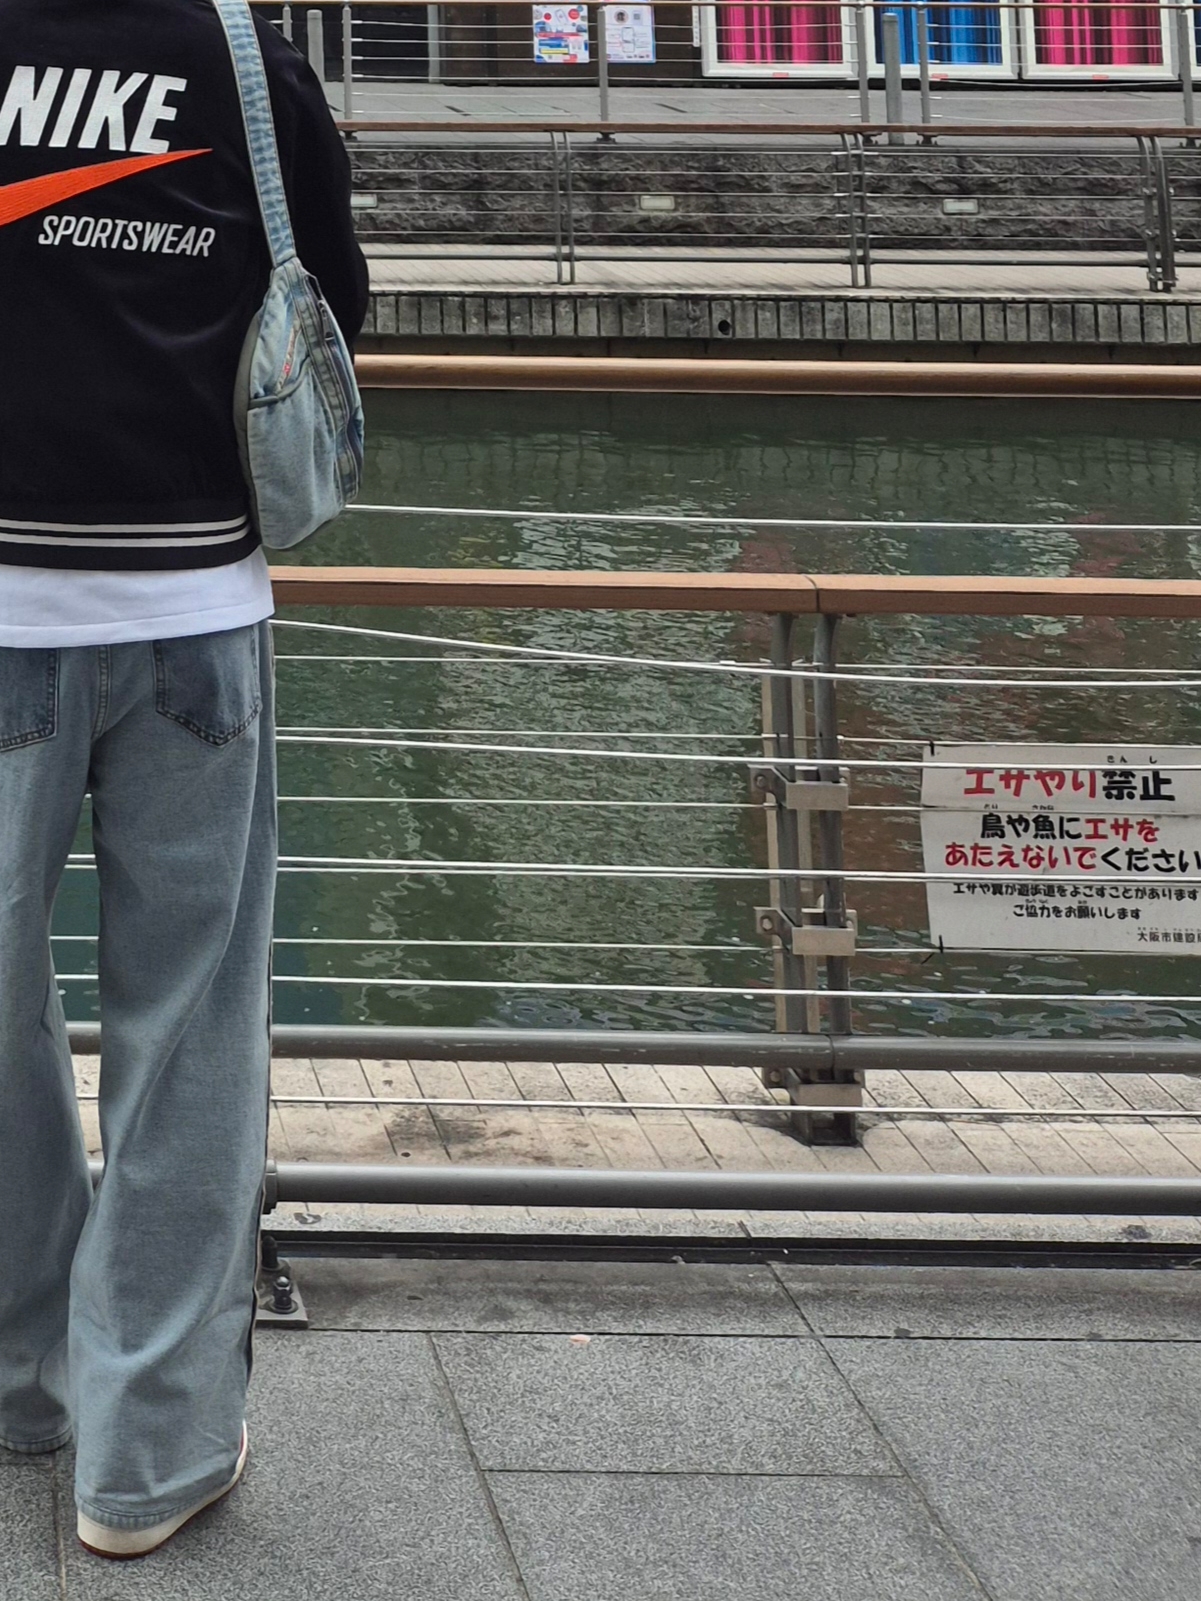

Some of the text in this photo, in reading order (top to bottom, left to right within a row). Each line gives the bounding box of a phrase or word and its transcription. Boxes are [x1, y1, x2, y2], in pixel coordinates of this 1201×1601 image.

[38, 215, 216, 257] SPORTSWEAR
[964, 769, 1176, 801] エサやり禁止
[980, 812, 1161, 843] 鳥や魚にエサを
[944, 842, 1201, 874] あたえないでください
[1012, 904, 1143, 920] ご協力をお願いします
